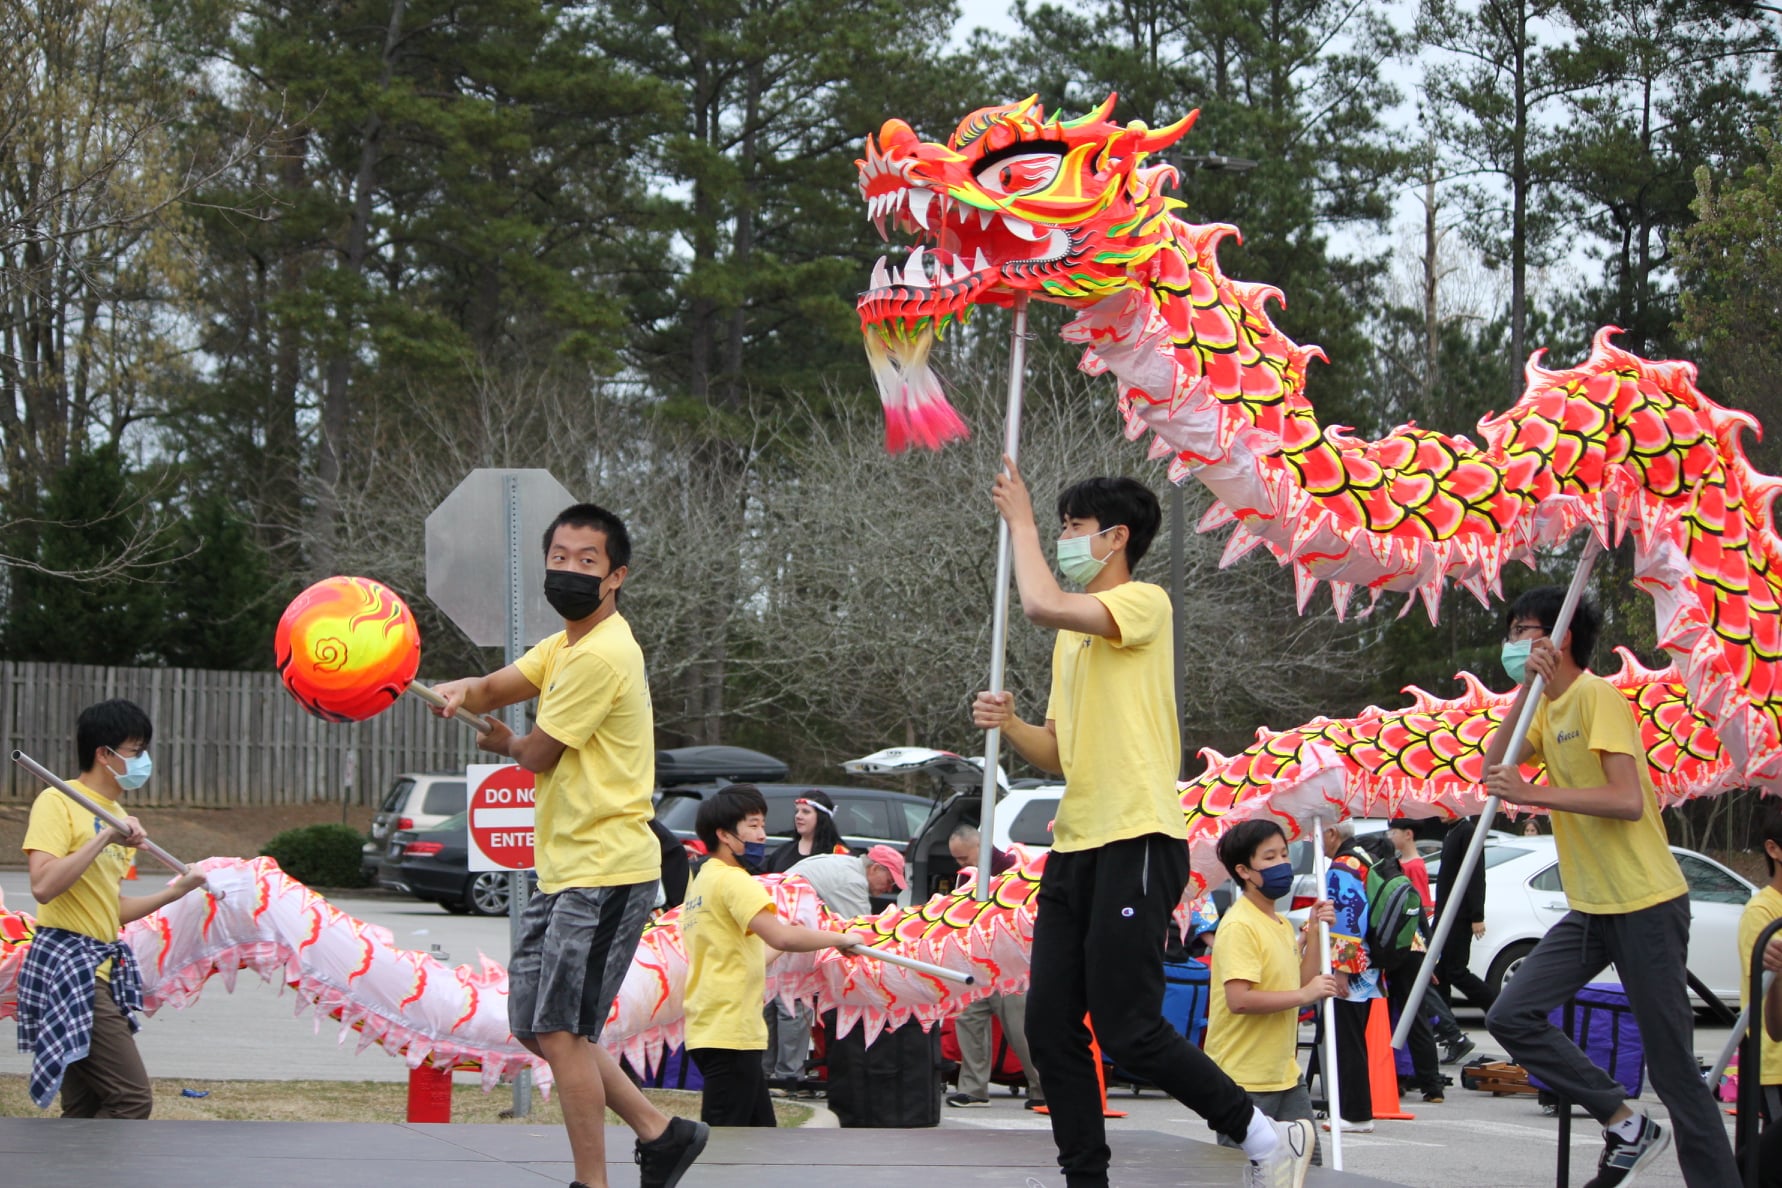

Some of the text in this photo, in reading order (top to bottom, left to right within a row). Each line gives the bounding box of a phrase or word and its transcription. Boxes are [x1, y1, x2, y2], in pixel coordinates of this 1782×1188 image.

[485, 788, 536, 804] DO NO
[490, 832, 535, 848] ENTE
